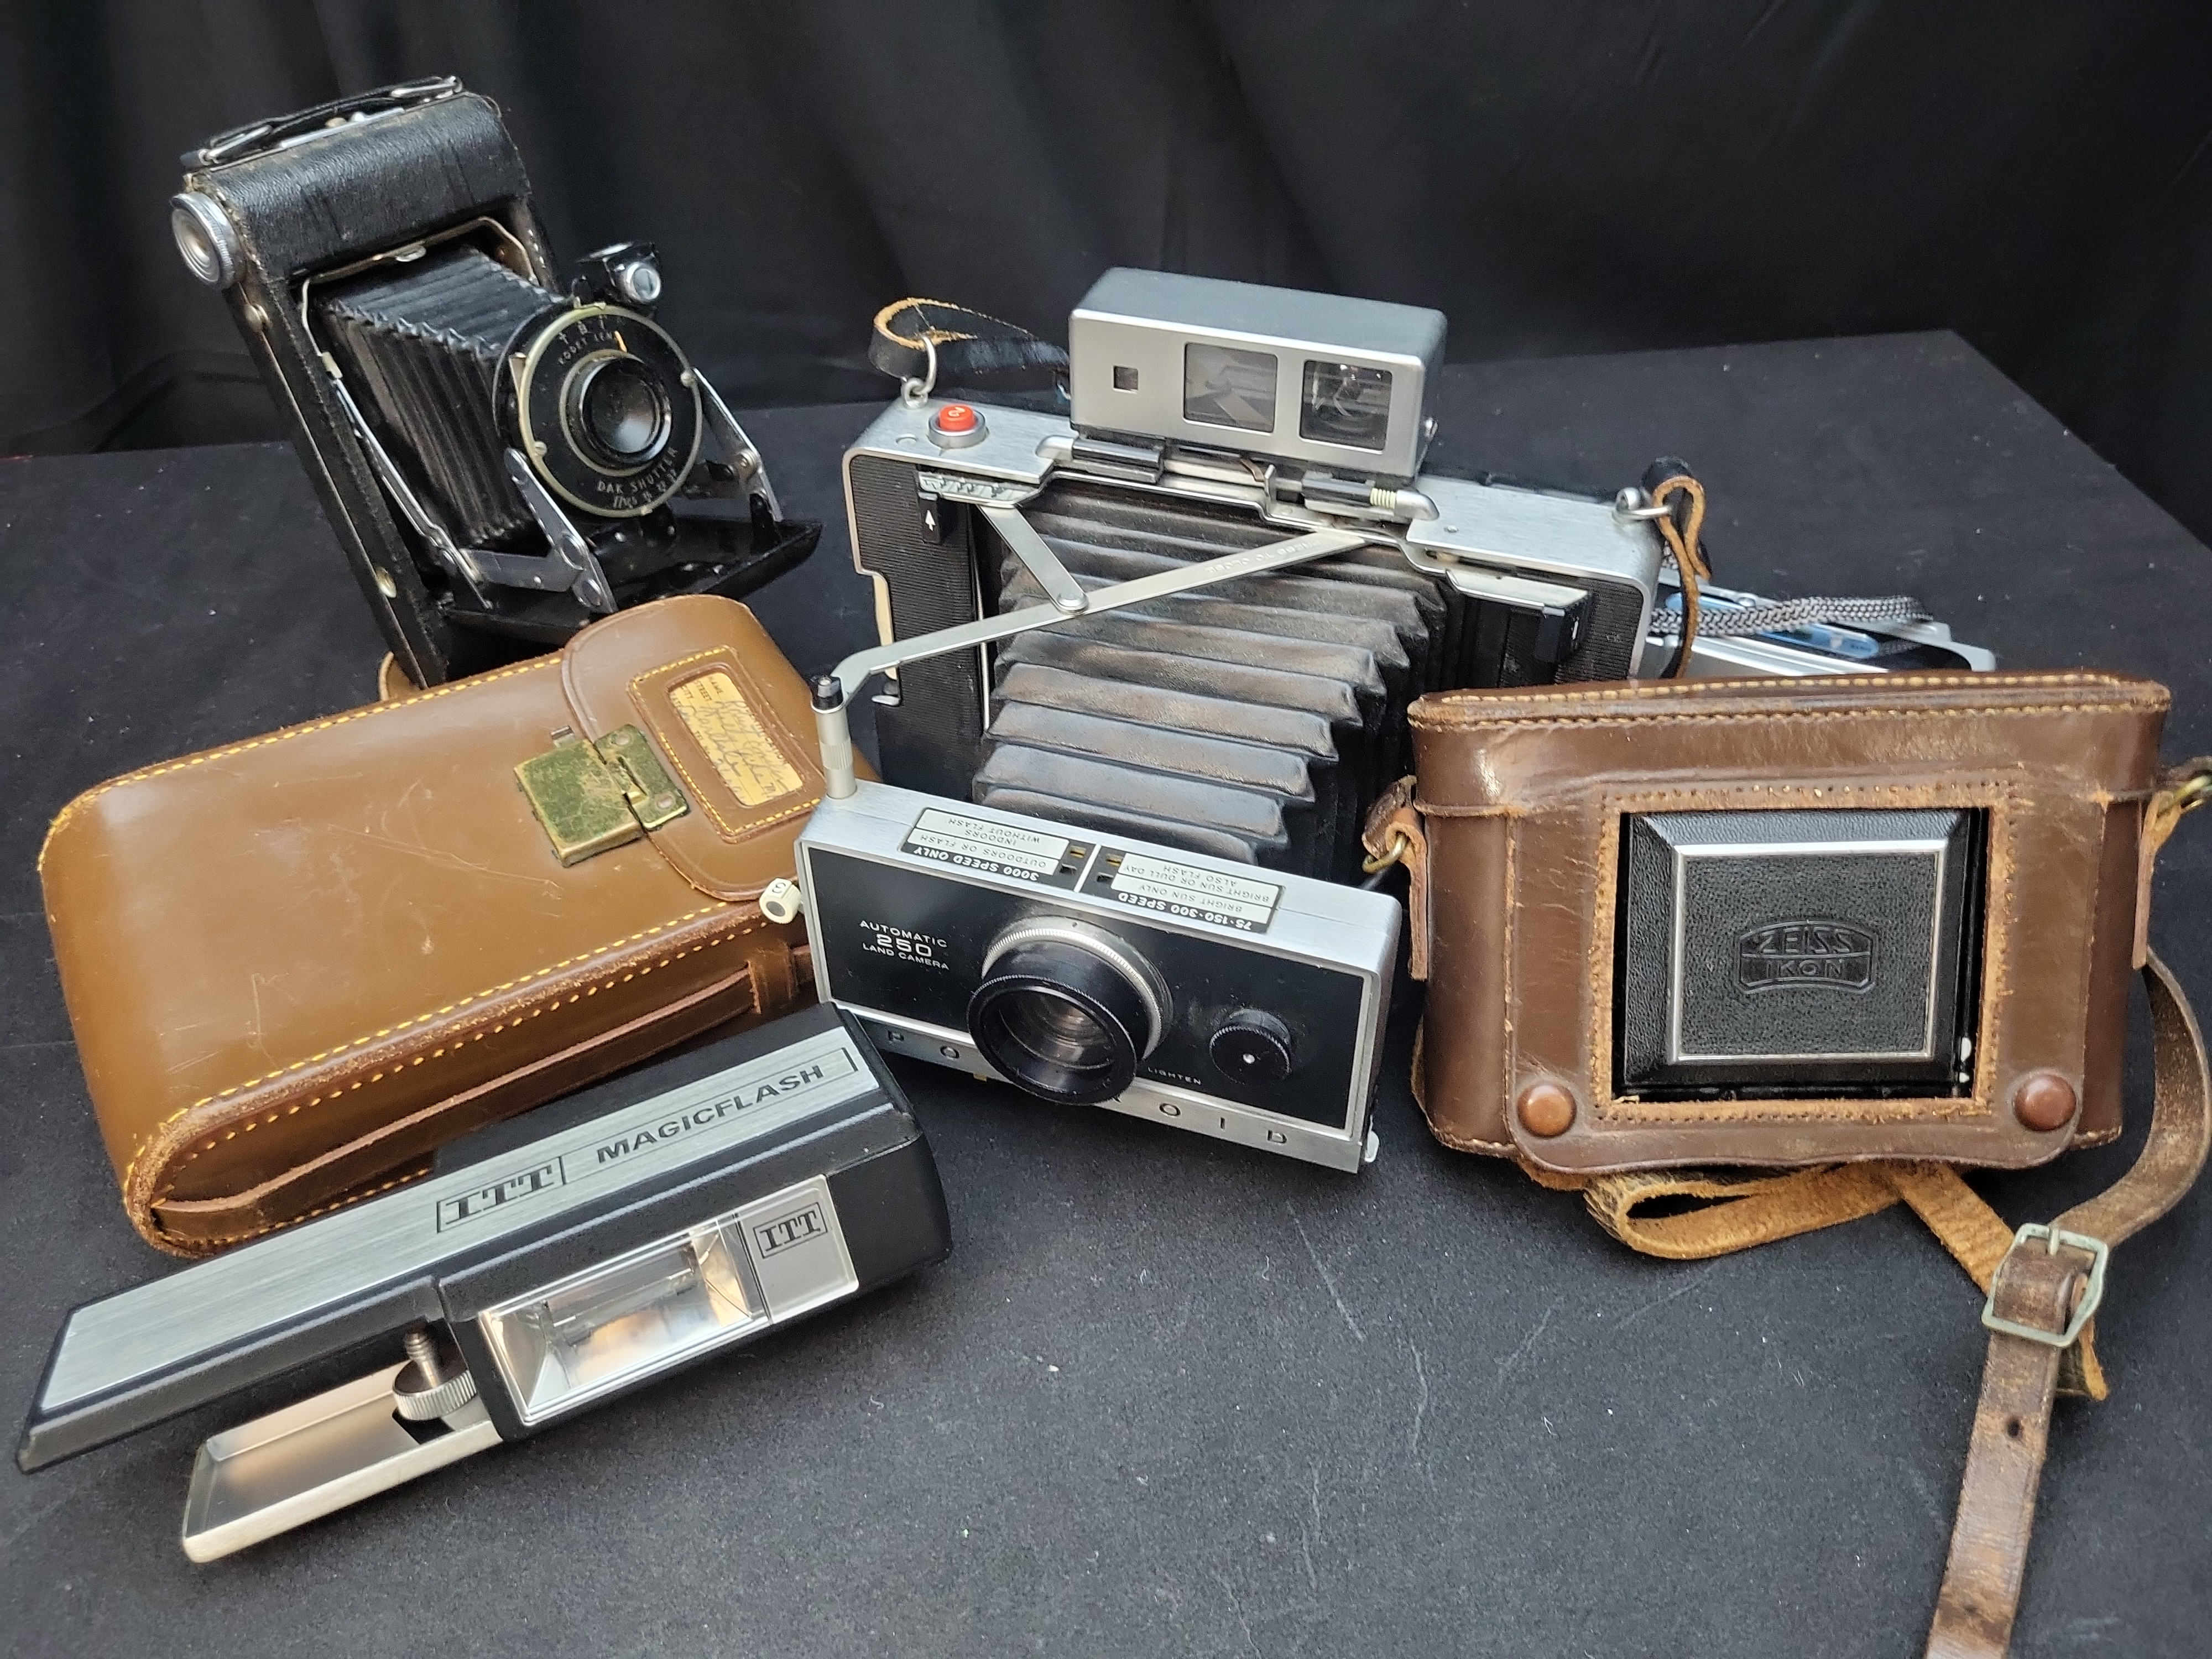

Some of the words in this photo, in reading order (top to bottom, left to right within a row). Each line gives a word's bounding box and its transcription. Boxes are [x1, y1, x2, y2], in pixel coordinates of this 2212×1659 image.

[947, 817, 984, 830] FLASH
[920, 834, 956, 848] FLASH
[964, 829, 1018, 847] INDOORS
[989, 826, 1041, 844] WITHOUT
[914, 846, 950, 861] ONLY
[961, 842, 977, 852] OR
[953, 855, 1000, 873] SPEED
[982, 848, 1047, 869] OUTDOORS
[1003, 865, 1040, 881] 3000
[1124, 864, 1146, 875] DAY
[1150, 869, 1176, 882] DULL
[1162, 864, 1202, 879] FLASH
[772, 881, 786, 894] 3
[1180, 876, 1196, 886] OR
[1201, 881, 1224, 893] SUN
[1206, 874, 1238, 887] ALSO
[1139, 884, 1168, 896] ONLY
[1171, 891, 1197, 902] SUN
[1227, 888, 1270, 902] BRIGHT
[1118, 892, 1167, 911] SPEED
[1199, 896, 1243, 913] BRIGHT
[859, 920, 948, 948] AUTOMATIC
[1757, 926, 1854, 954] ZEISS
[876, 933, 932, 957] 250
[862, 942, 895, 957] LAND
[898, 951, 950, 971] CAMERA
[1765, 958, 1844, 979] IKON
[1147, 1066, 1202, 1086] LIGHTEN
[445, 1164, 554, 1225] ITT
[597, 1065, 825, 1164] MAGICFLASH
[759, 1209, 821, 1252] ITT
